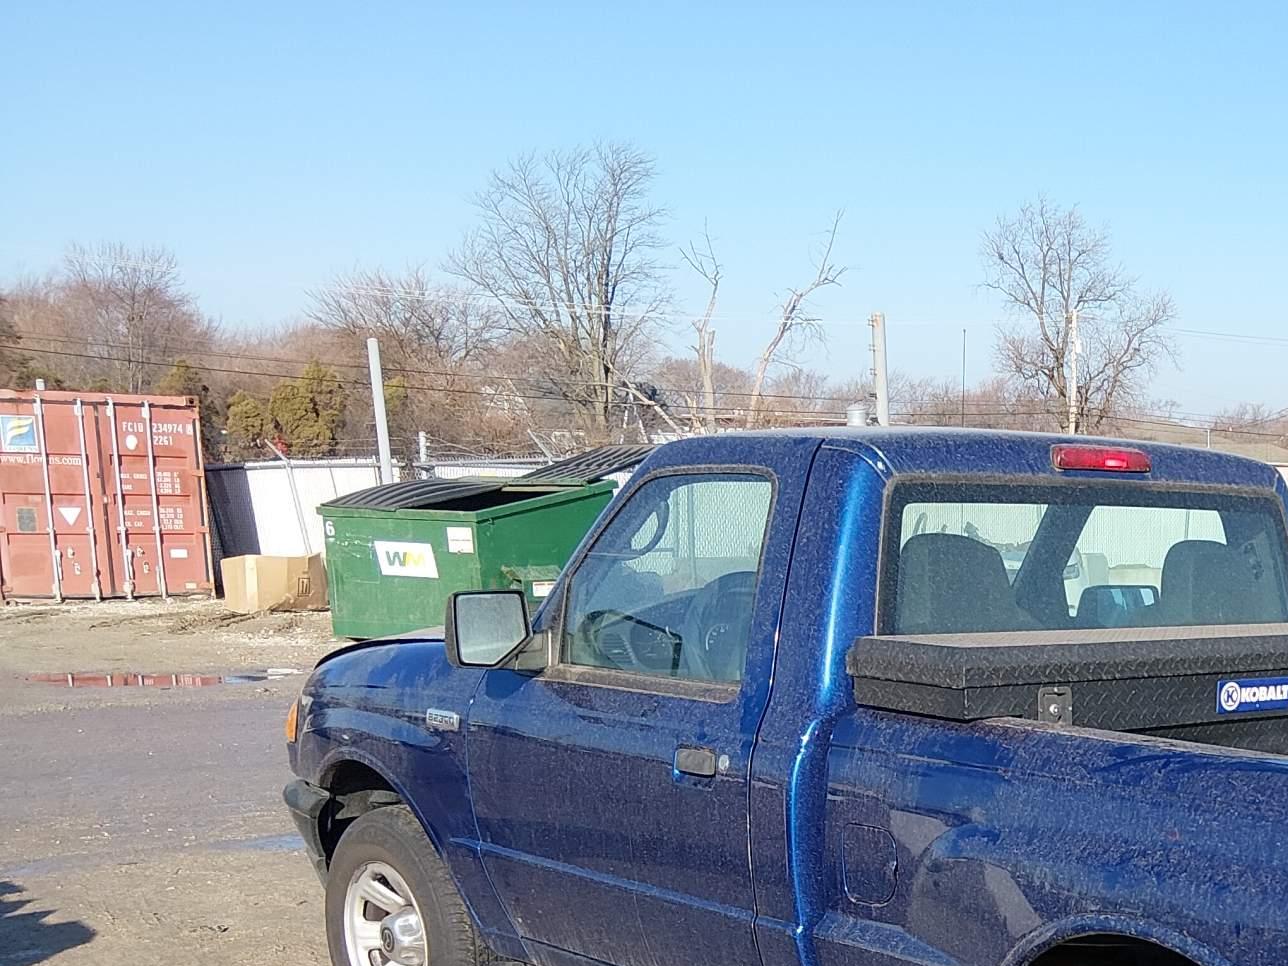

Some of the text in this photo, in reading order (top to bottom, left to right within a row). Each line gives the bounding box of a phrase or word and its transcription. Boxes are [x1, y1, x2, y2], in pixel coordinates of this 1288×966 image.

[0, 454, 82, 466] www.florns.com
[325, 521, 336, 536] 6
[385, 550, 425, 568] WM
